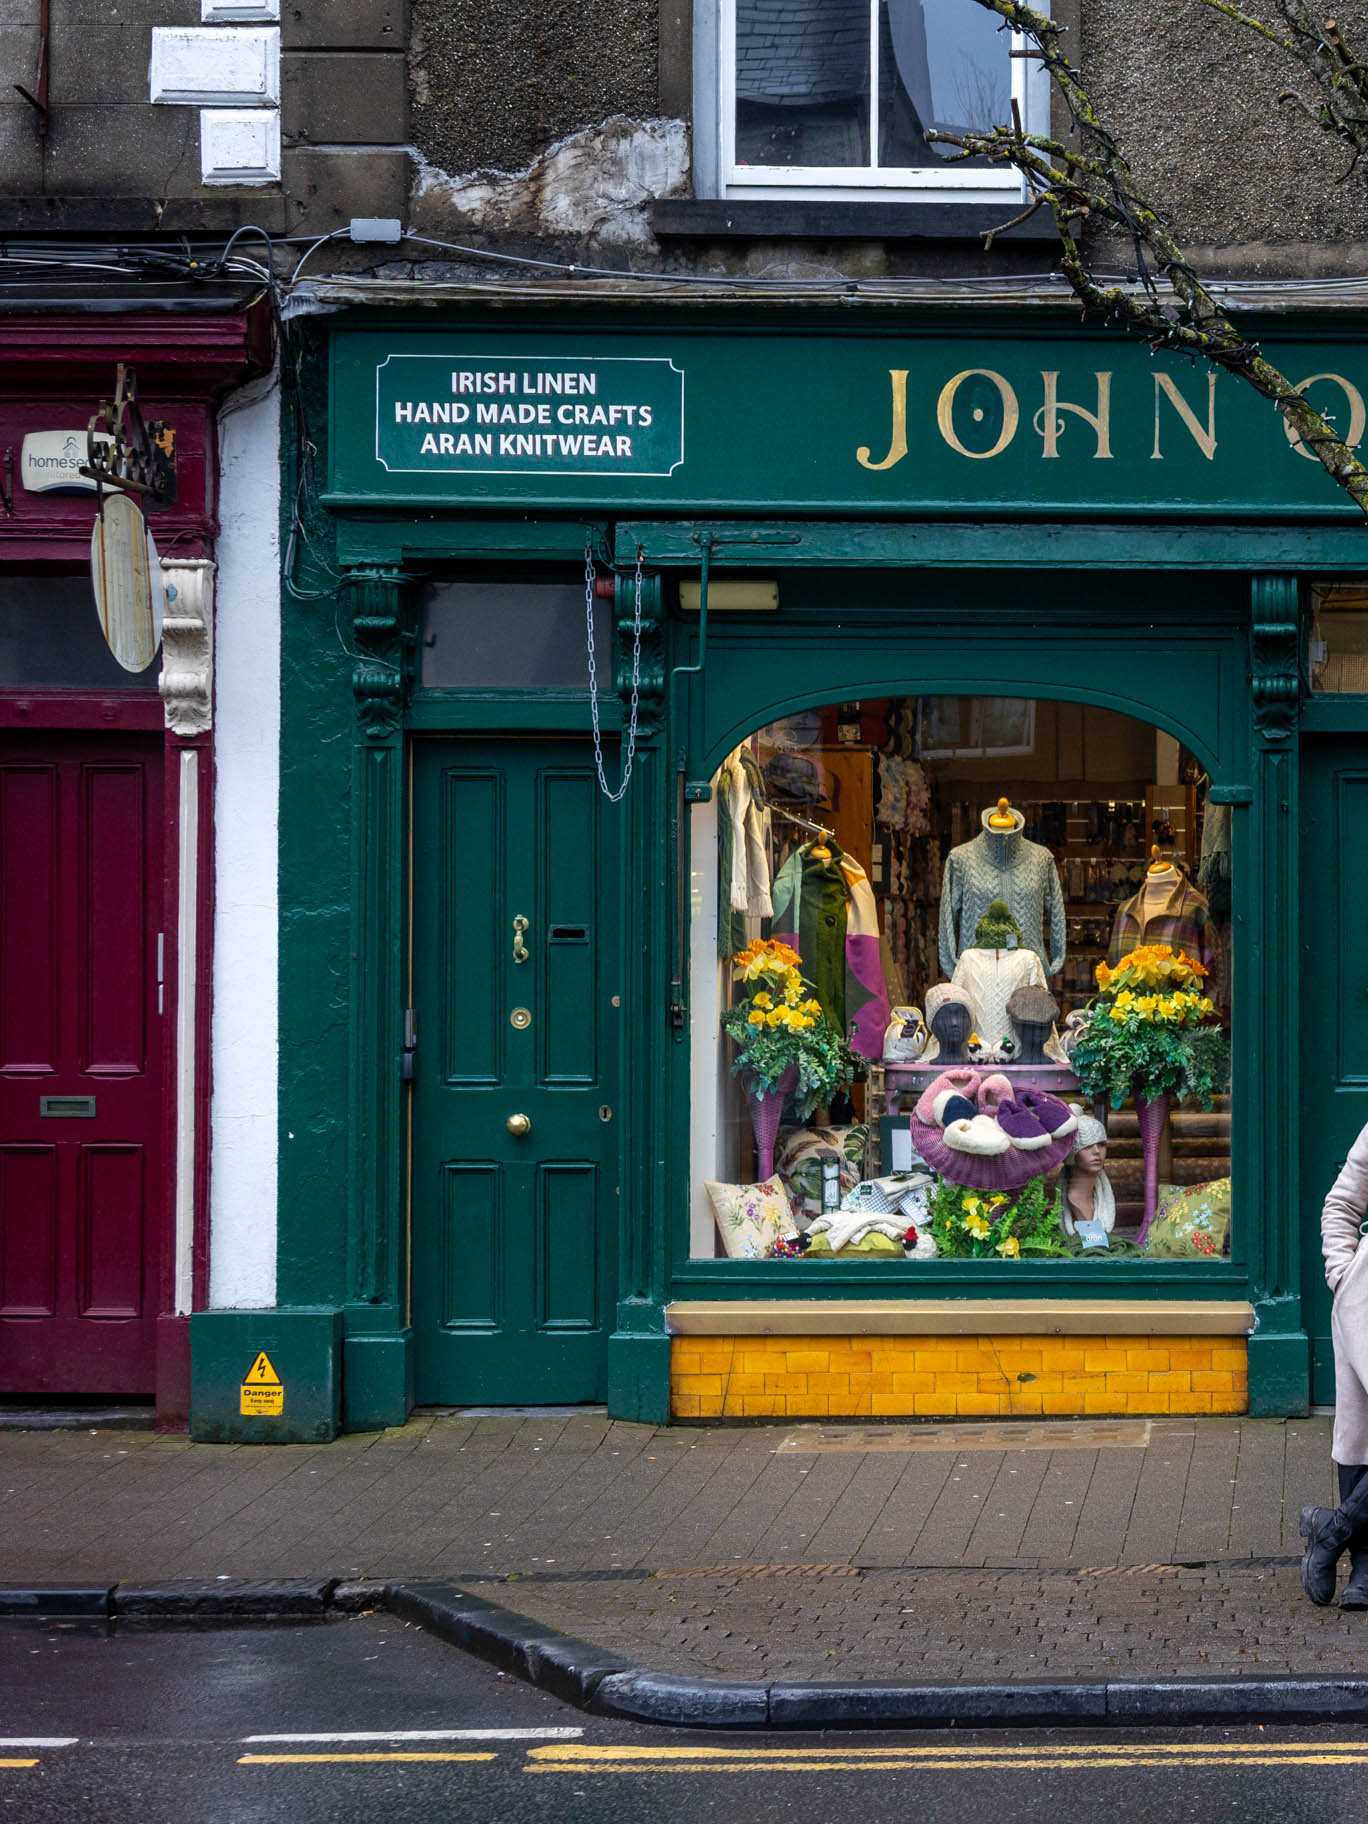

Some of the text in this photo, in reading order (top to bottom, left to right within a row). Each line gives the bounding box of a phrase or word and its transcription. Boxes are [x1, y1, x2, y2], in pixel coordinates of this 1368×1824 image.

[450, 371, 597, 397] IRISH LINEN
[393, 401, 653, 427] HAND MADE CRAFTS
[855, 368, 1219, 471] JOHN
[419, 432, 634, 459] ARAN KNITWEAR
[243, 1389, 282, 1398] Danger
